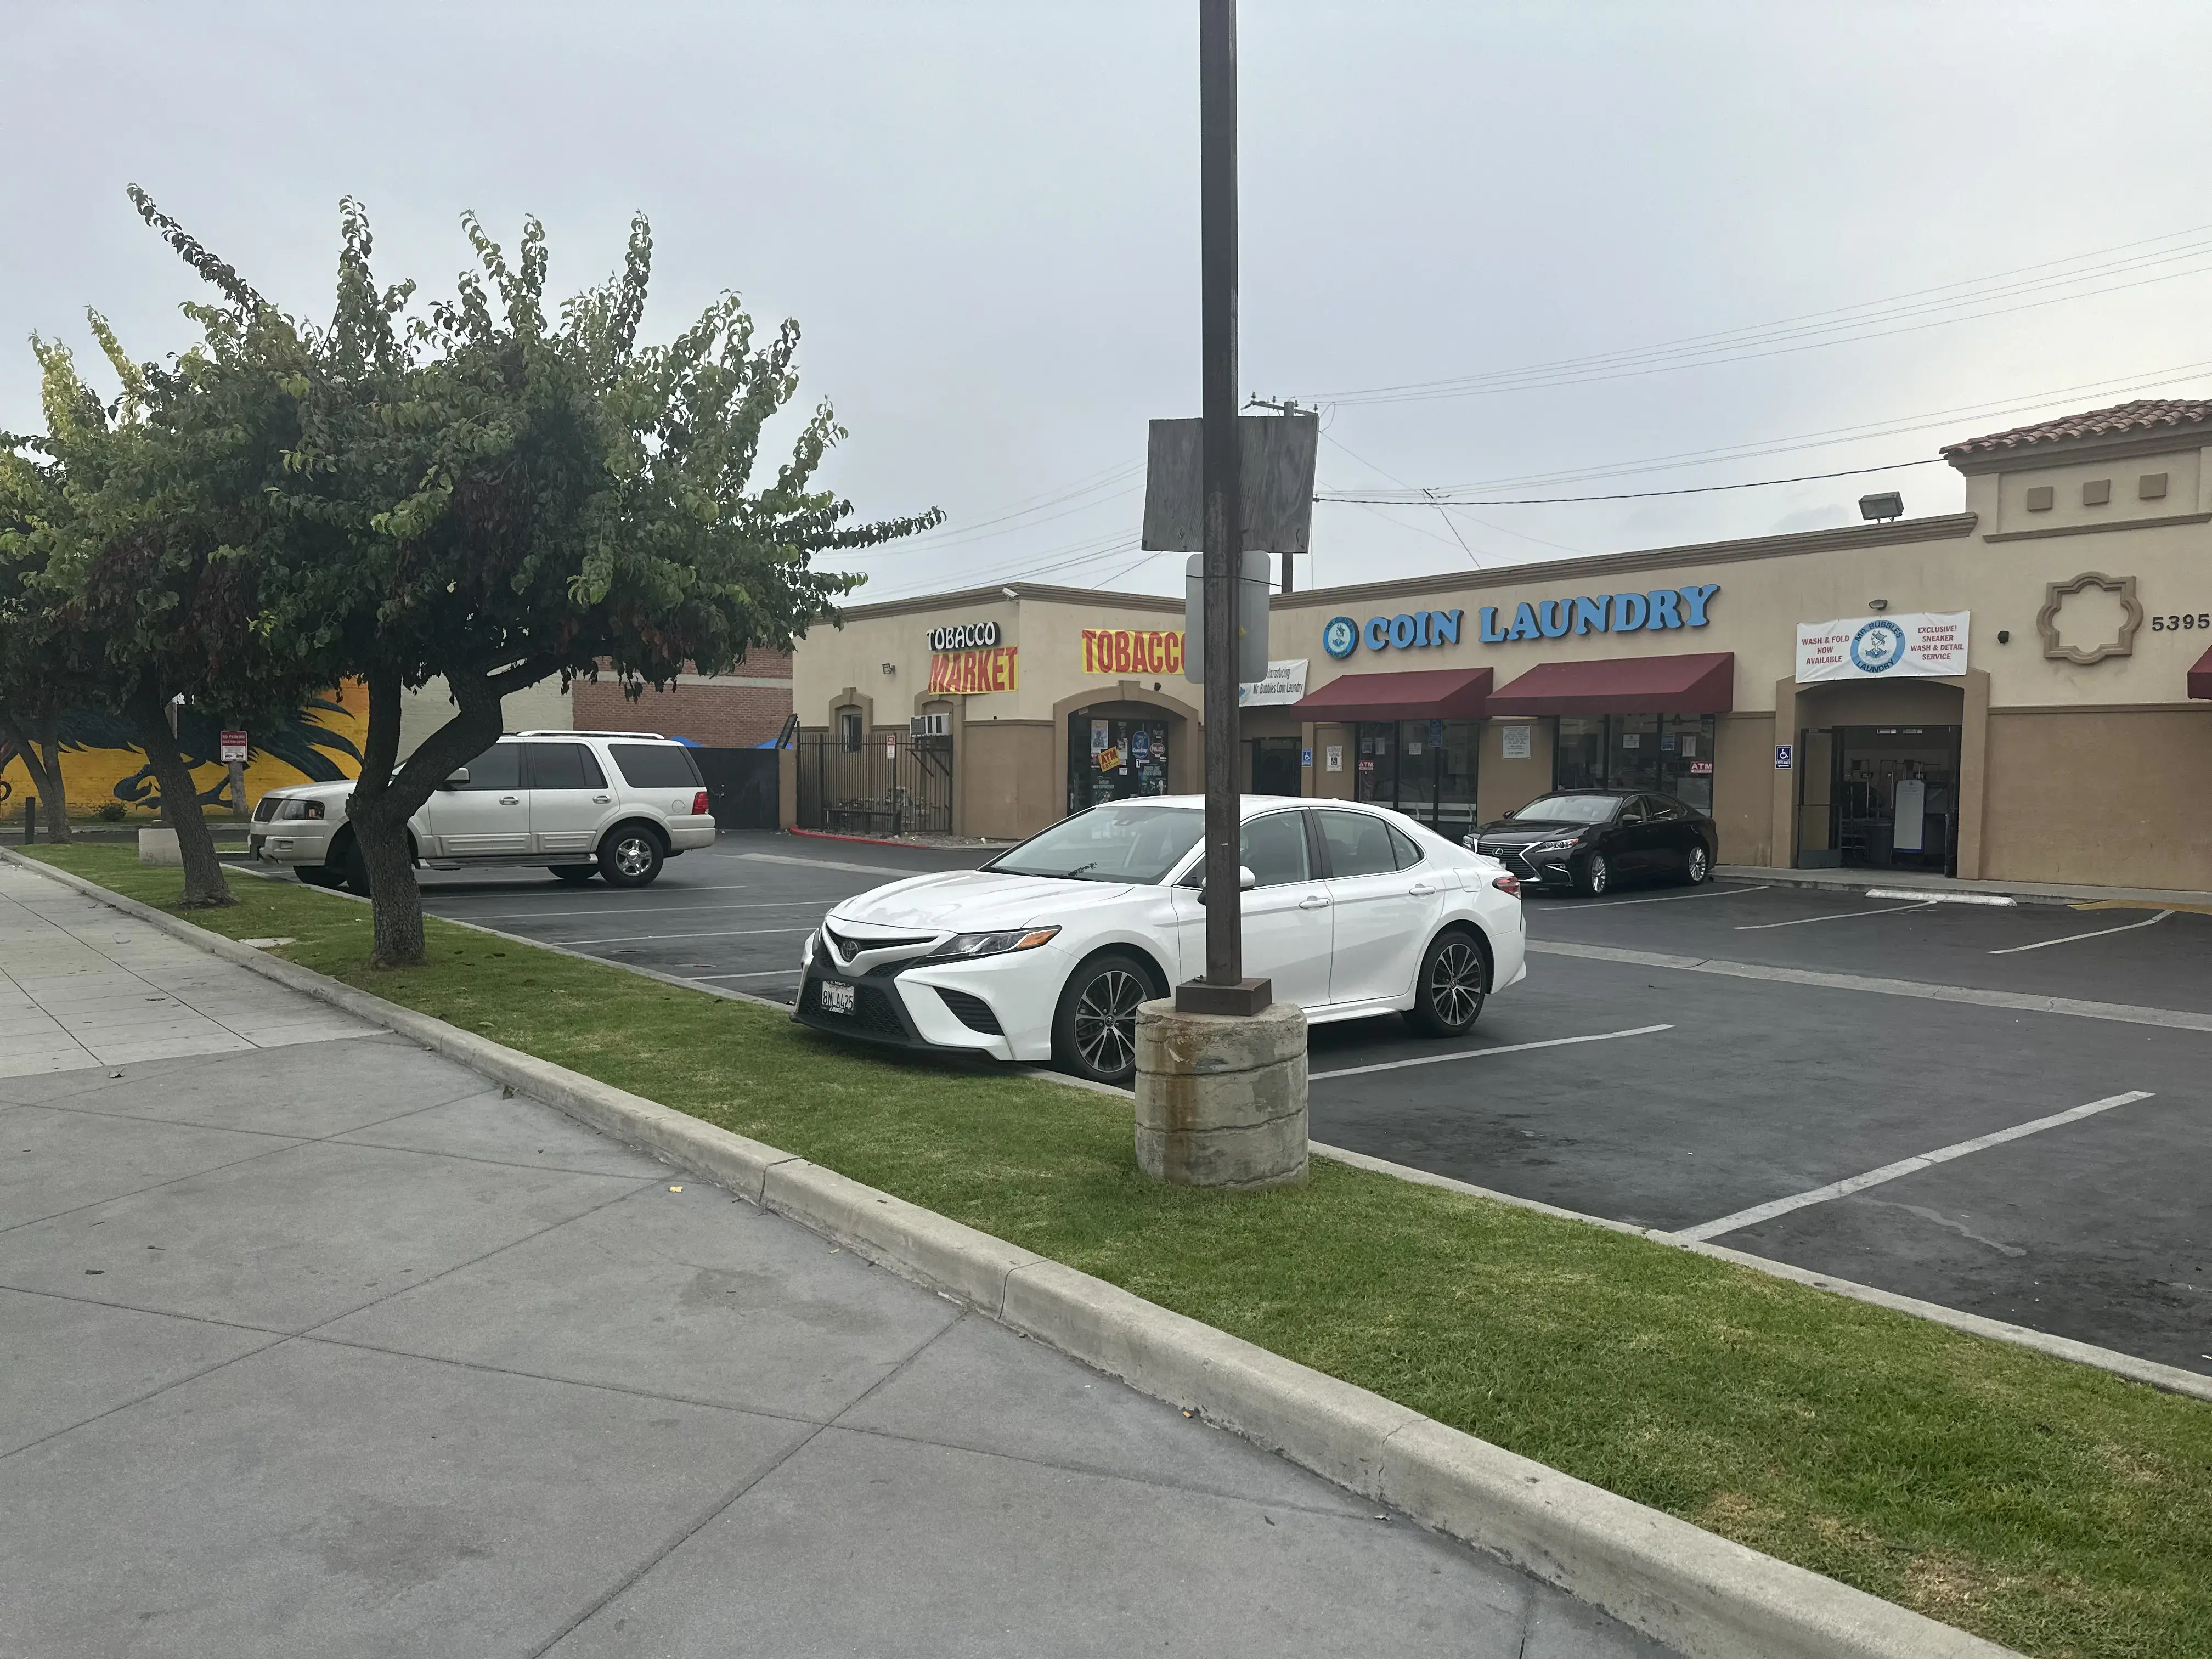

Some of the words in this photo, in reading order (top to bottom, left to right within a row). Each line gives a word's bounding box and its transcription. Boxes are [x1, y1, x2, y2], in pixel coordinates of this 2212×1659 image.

[1364, 609, 1464, 650] COIN
[1479, 584, 1720, 642] LAUNDRY
[2152, 613, 2210, 631] 5395
[926, 621, 997, 651] TOBACCO
[1855, 628, 1867, 641] MR.
[1869, 621, 1903, 639] BUBBLES
[1802, 637, 1822, 645] WASH
[1082, 630, 1186, 673] TOBACC
[1806, 656, 1842, 665] AVAILABLE
[928, 647, 1018, 692] MARKET
[1857, 658, 1894, 673] LAUNDRY
[1260, 682, 1276, 694] Bubbles
[1277, 682, 1286, 693] Coin
[1286, 681, 1303, 695] Laundry
[1101, 749, 1117, 765] ATM
[823, 990, 853, 1010] 8NLA425
